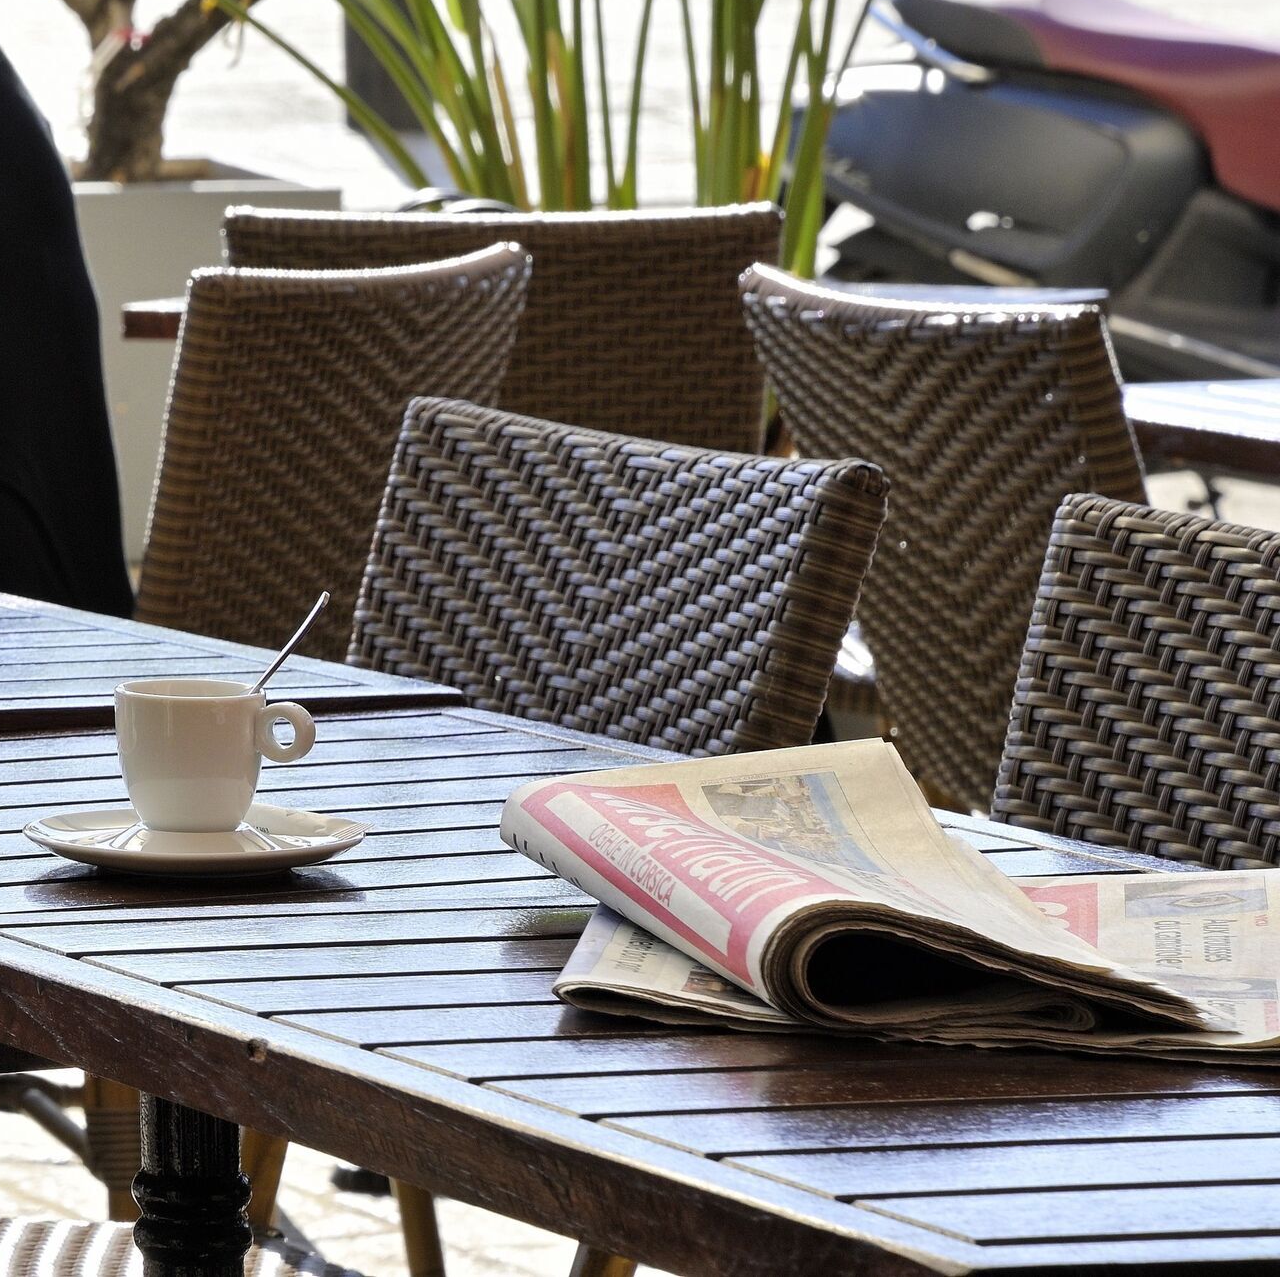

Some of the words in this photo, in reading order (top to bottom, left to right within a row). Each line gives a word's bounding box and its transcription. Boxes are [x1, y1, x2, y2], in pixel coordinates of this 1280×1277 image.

[589, 823, 630, 861] OGHJE
[618, 845, 641, 872] IN
[629, 854, 677, 908] CORSICA
[1153, 920, 1192, 930] du
[1203, 918, 1238, 935] Aux
[1203, 935, 1238, 963] trousses
